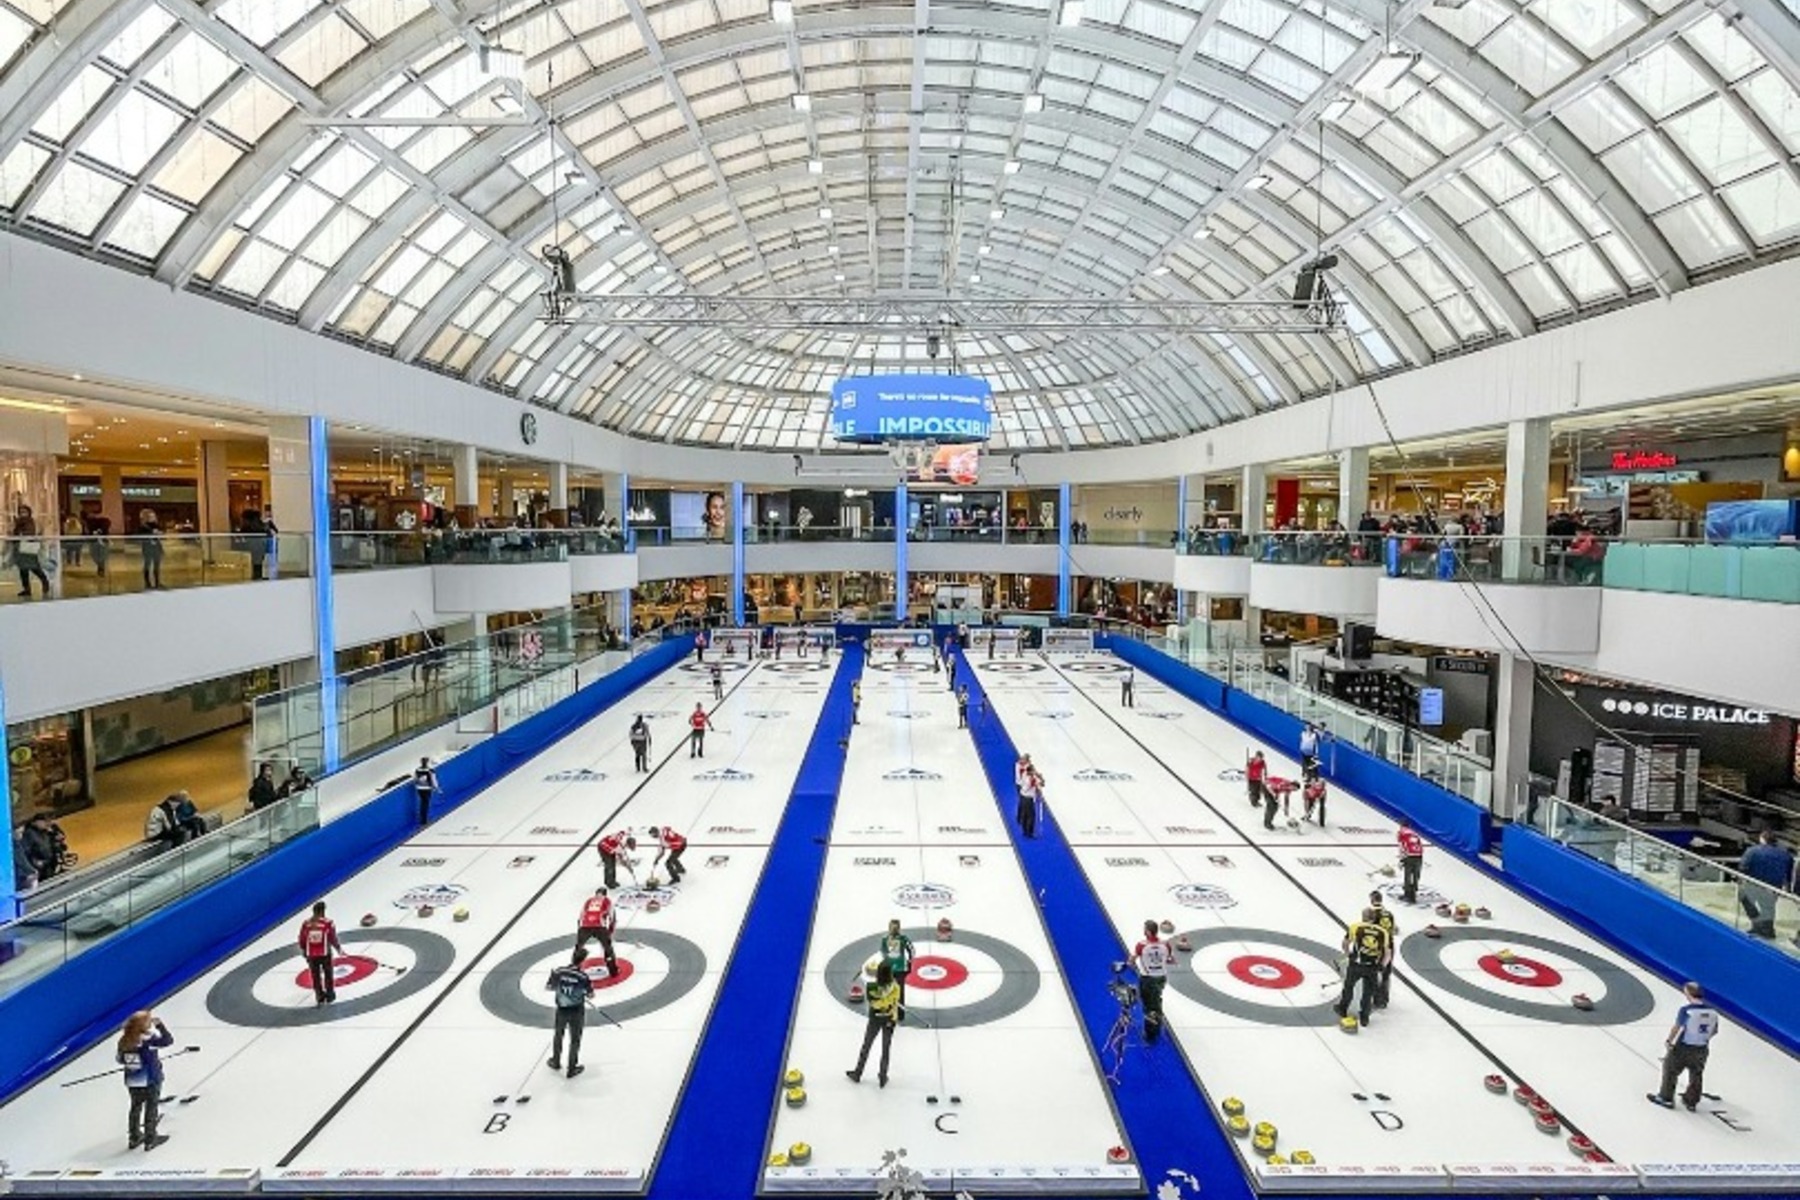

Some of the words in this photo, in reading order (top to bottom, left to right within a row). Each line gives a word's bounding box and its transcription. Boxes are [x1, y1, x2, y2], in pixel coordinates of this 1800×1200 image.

[1652, 704, 1687, 719] ICE
[1693, 706, 1770, 723] PALACE
[483, 1113, 511, 1134] B
[935, 1113, 958, 1134] C
[1370, 1111, 1403, 1131] D
